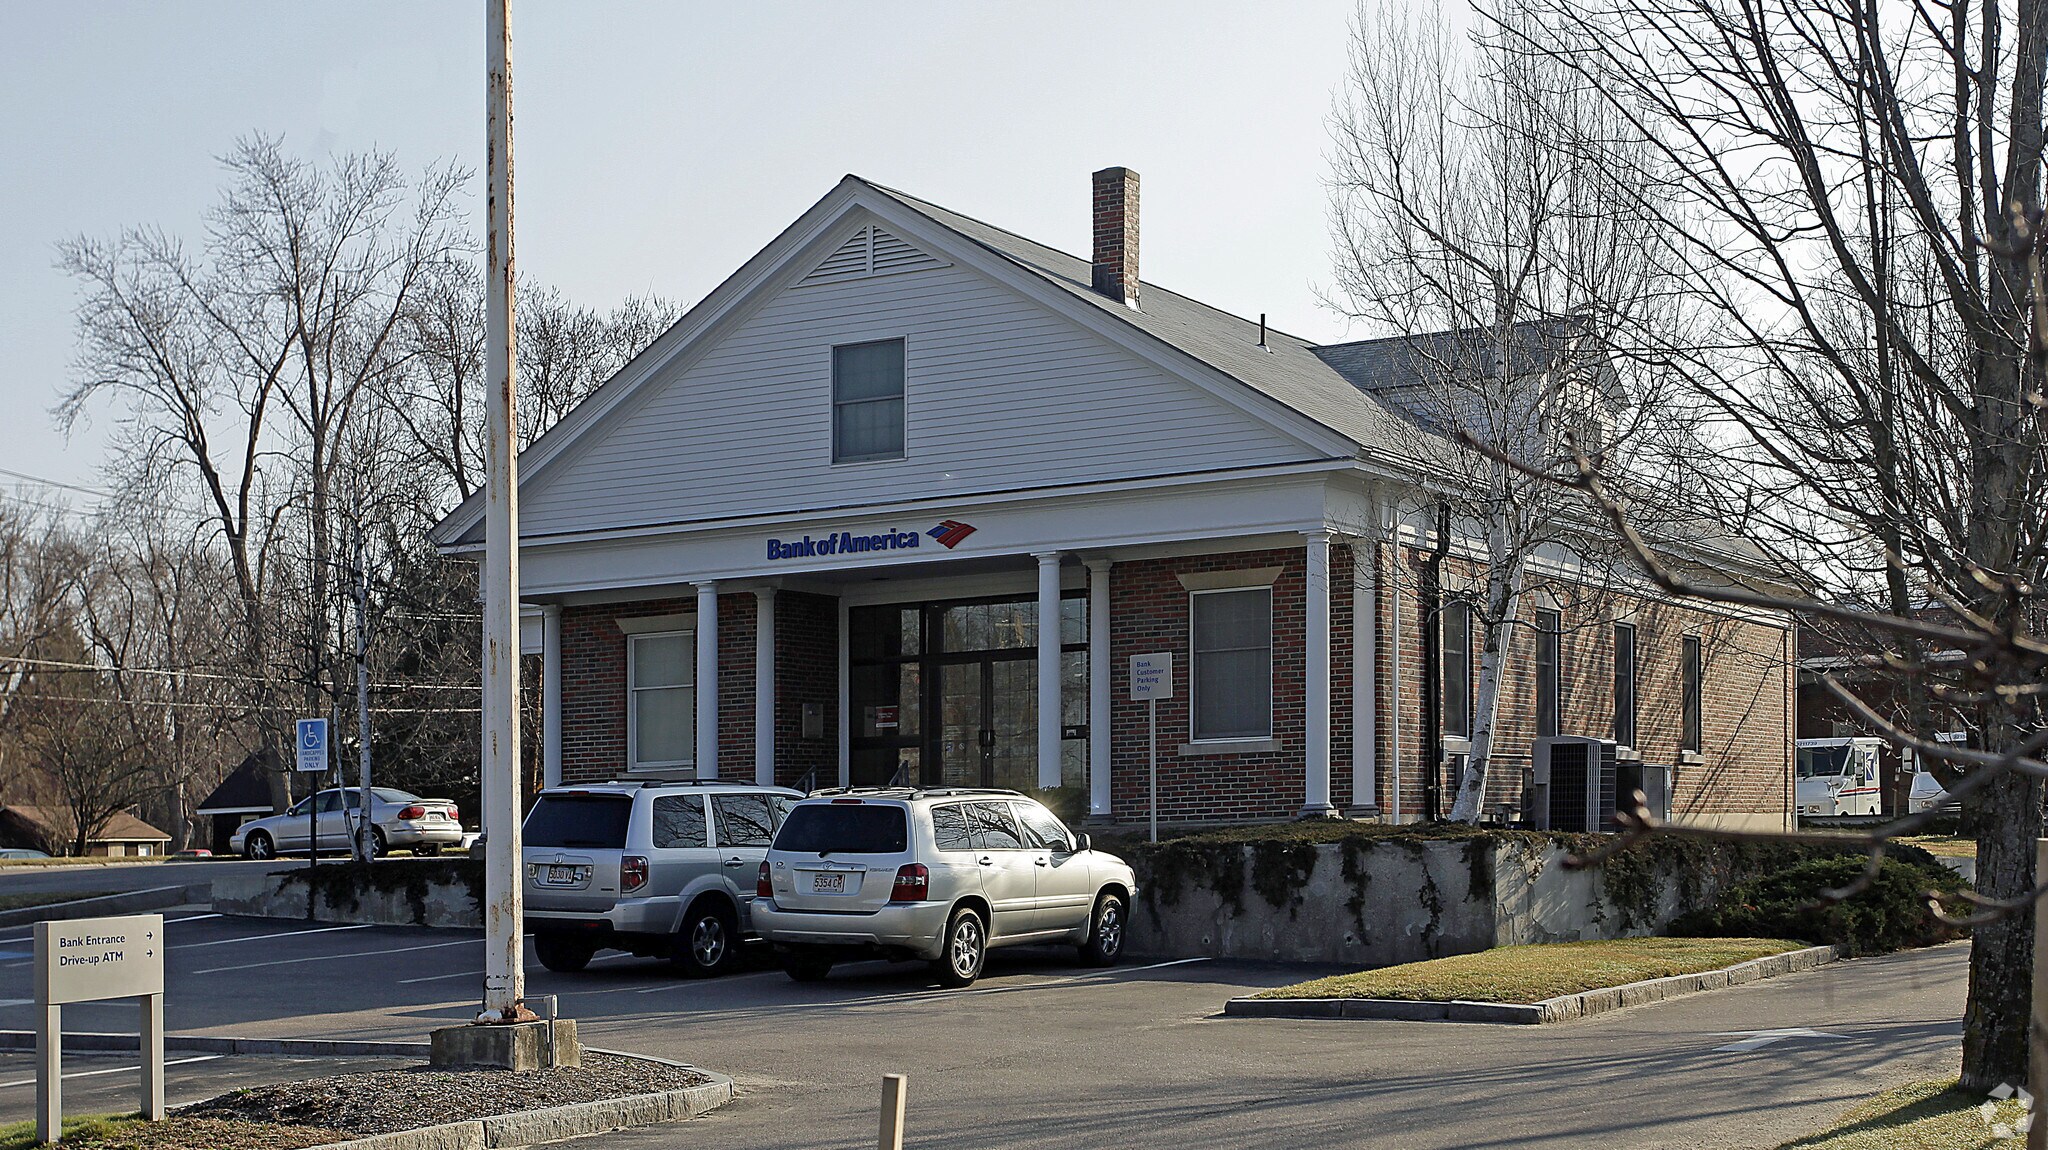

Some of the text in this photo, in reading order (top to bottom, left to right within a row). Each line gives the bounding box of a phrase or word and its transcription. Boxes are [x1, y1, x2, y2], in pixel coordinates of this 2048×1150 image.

[767, 528, 920, 560] Bank of America
[814, 877, 832, 888] 5354
[59, 934, 126, 948] Bank Entrance
[59, 951, 124, 966] Drive-up ATM
